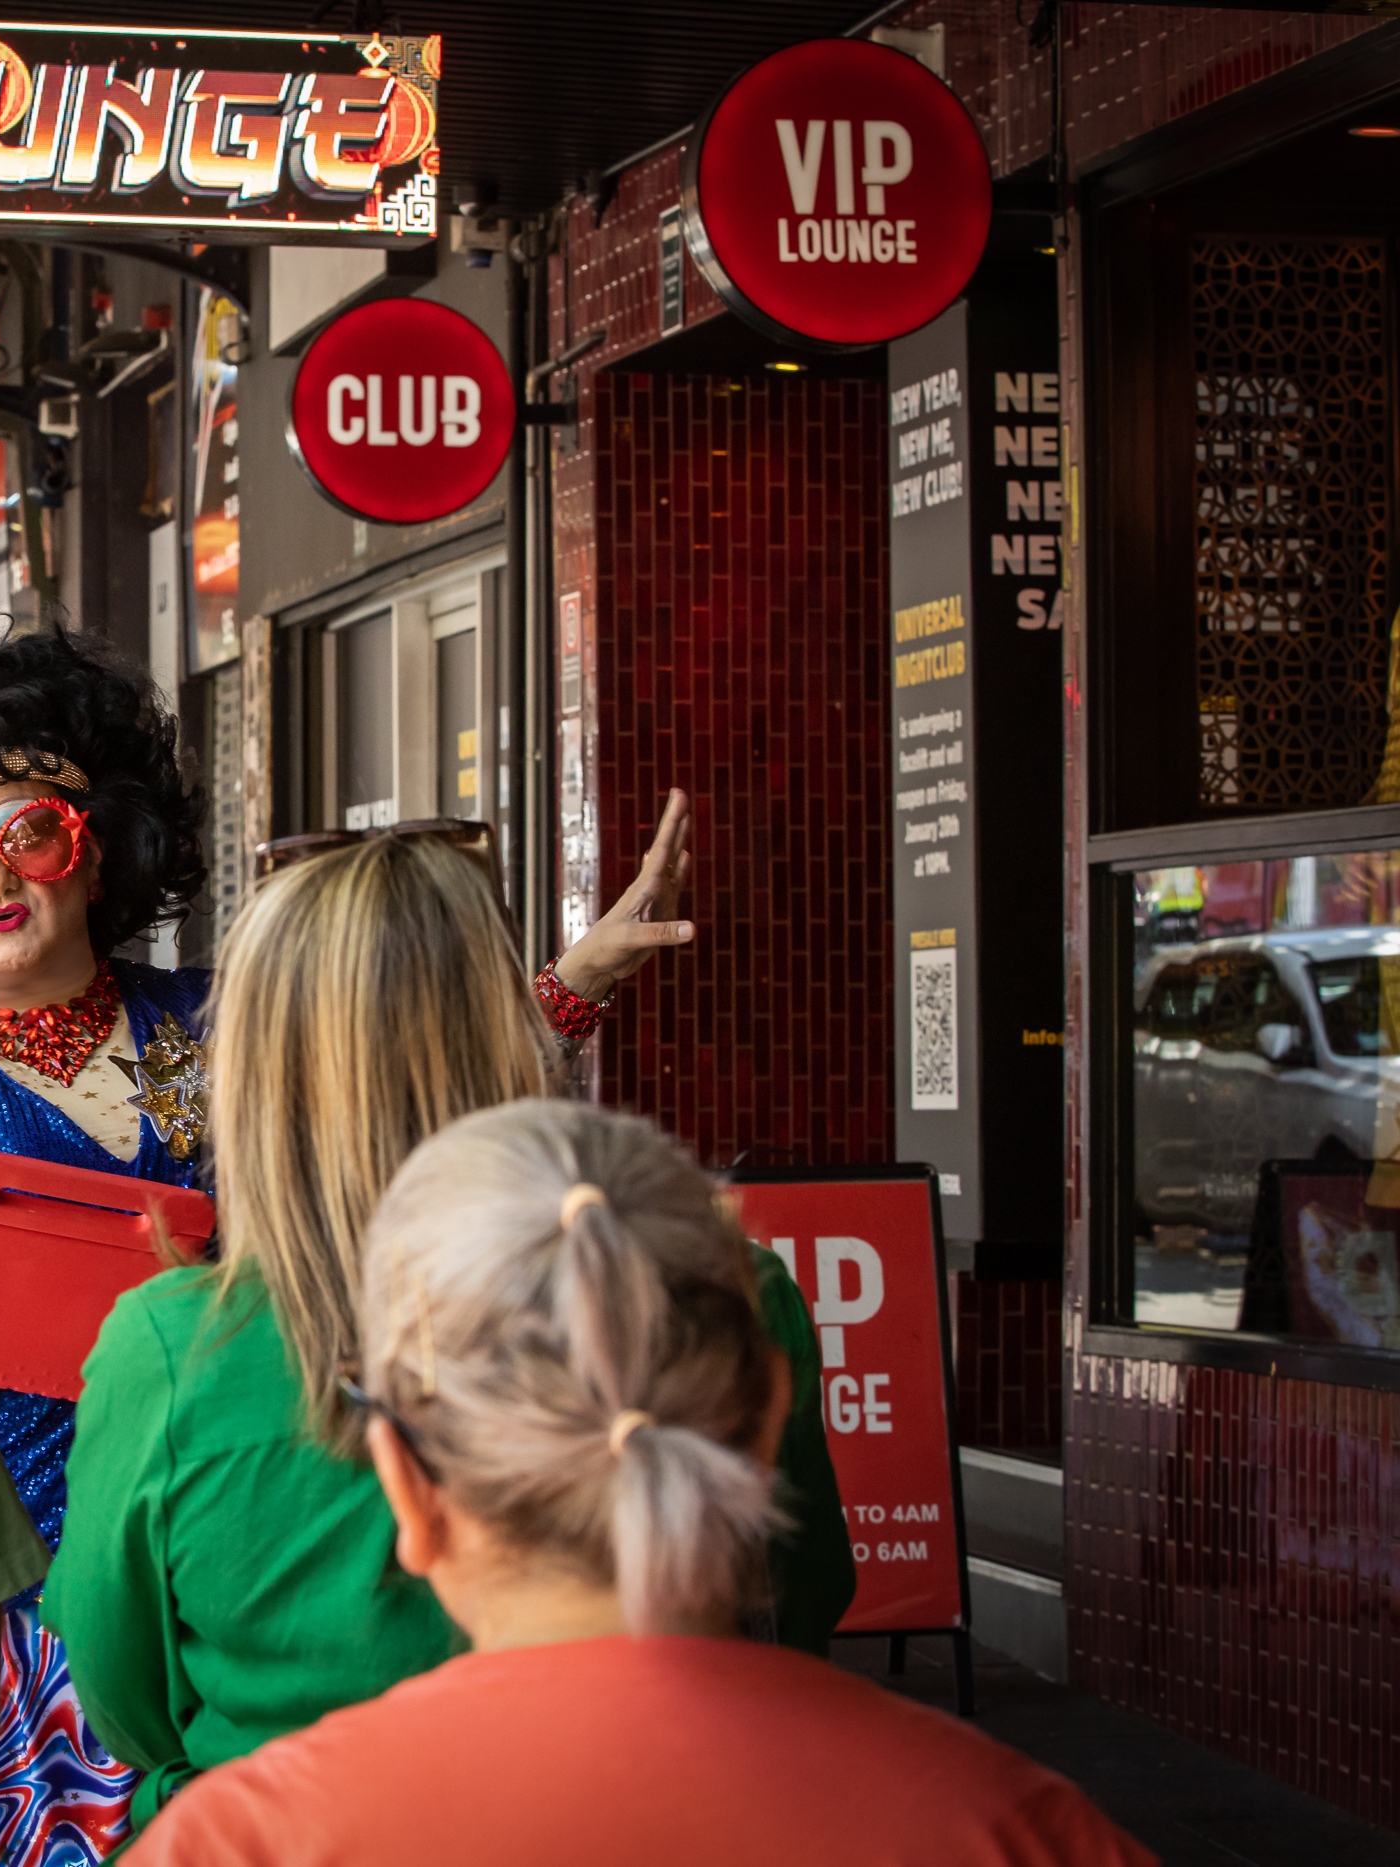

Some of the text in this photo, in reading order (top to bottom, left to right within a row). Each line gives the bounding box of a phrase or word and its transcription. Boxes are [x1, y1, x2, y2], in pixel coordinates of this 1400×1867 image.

[774, 119, 914, 216] VIP
[778, 218, 919, 264] LOUNGE
[327, 373, 482, 447] CLUB
[891, 381, 922, 426] NEW
[899, 425, 930, 469] NEW
[892, 474, 923, 518] NEW
[854, 1503, 940, 1524] TO 4AM
[850, 1541, 929, 1563] O 6AM
